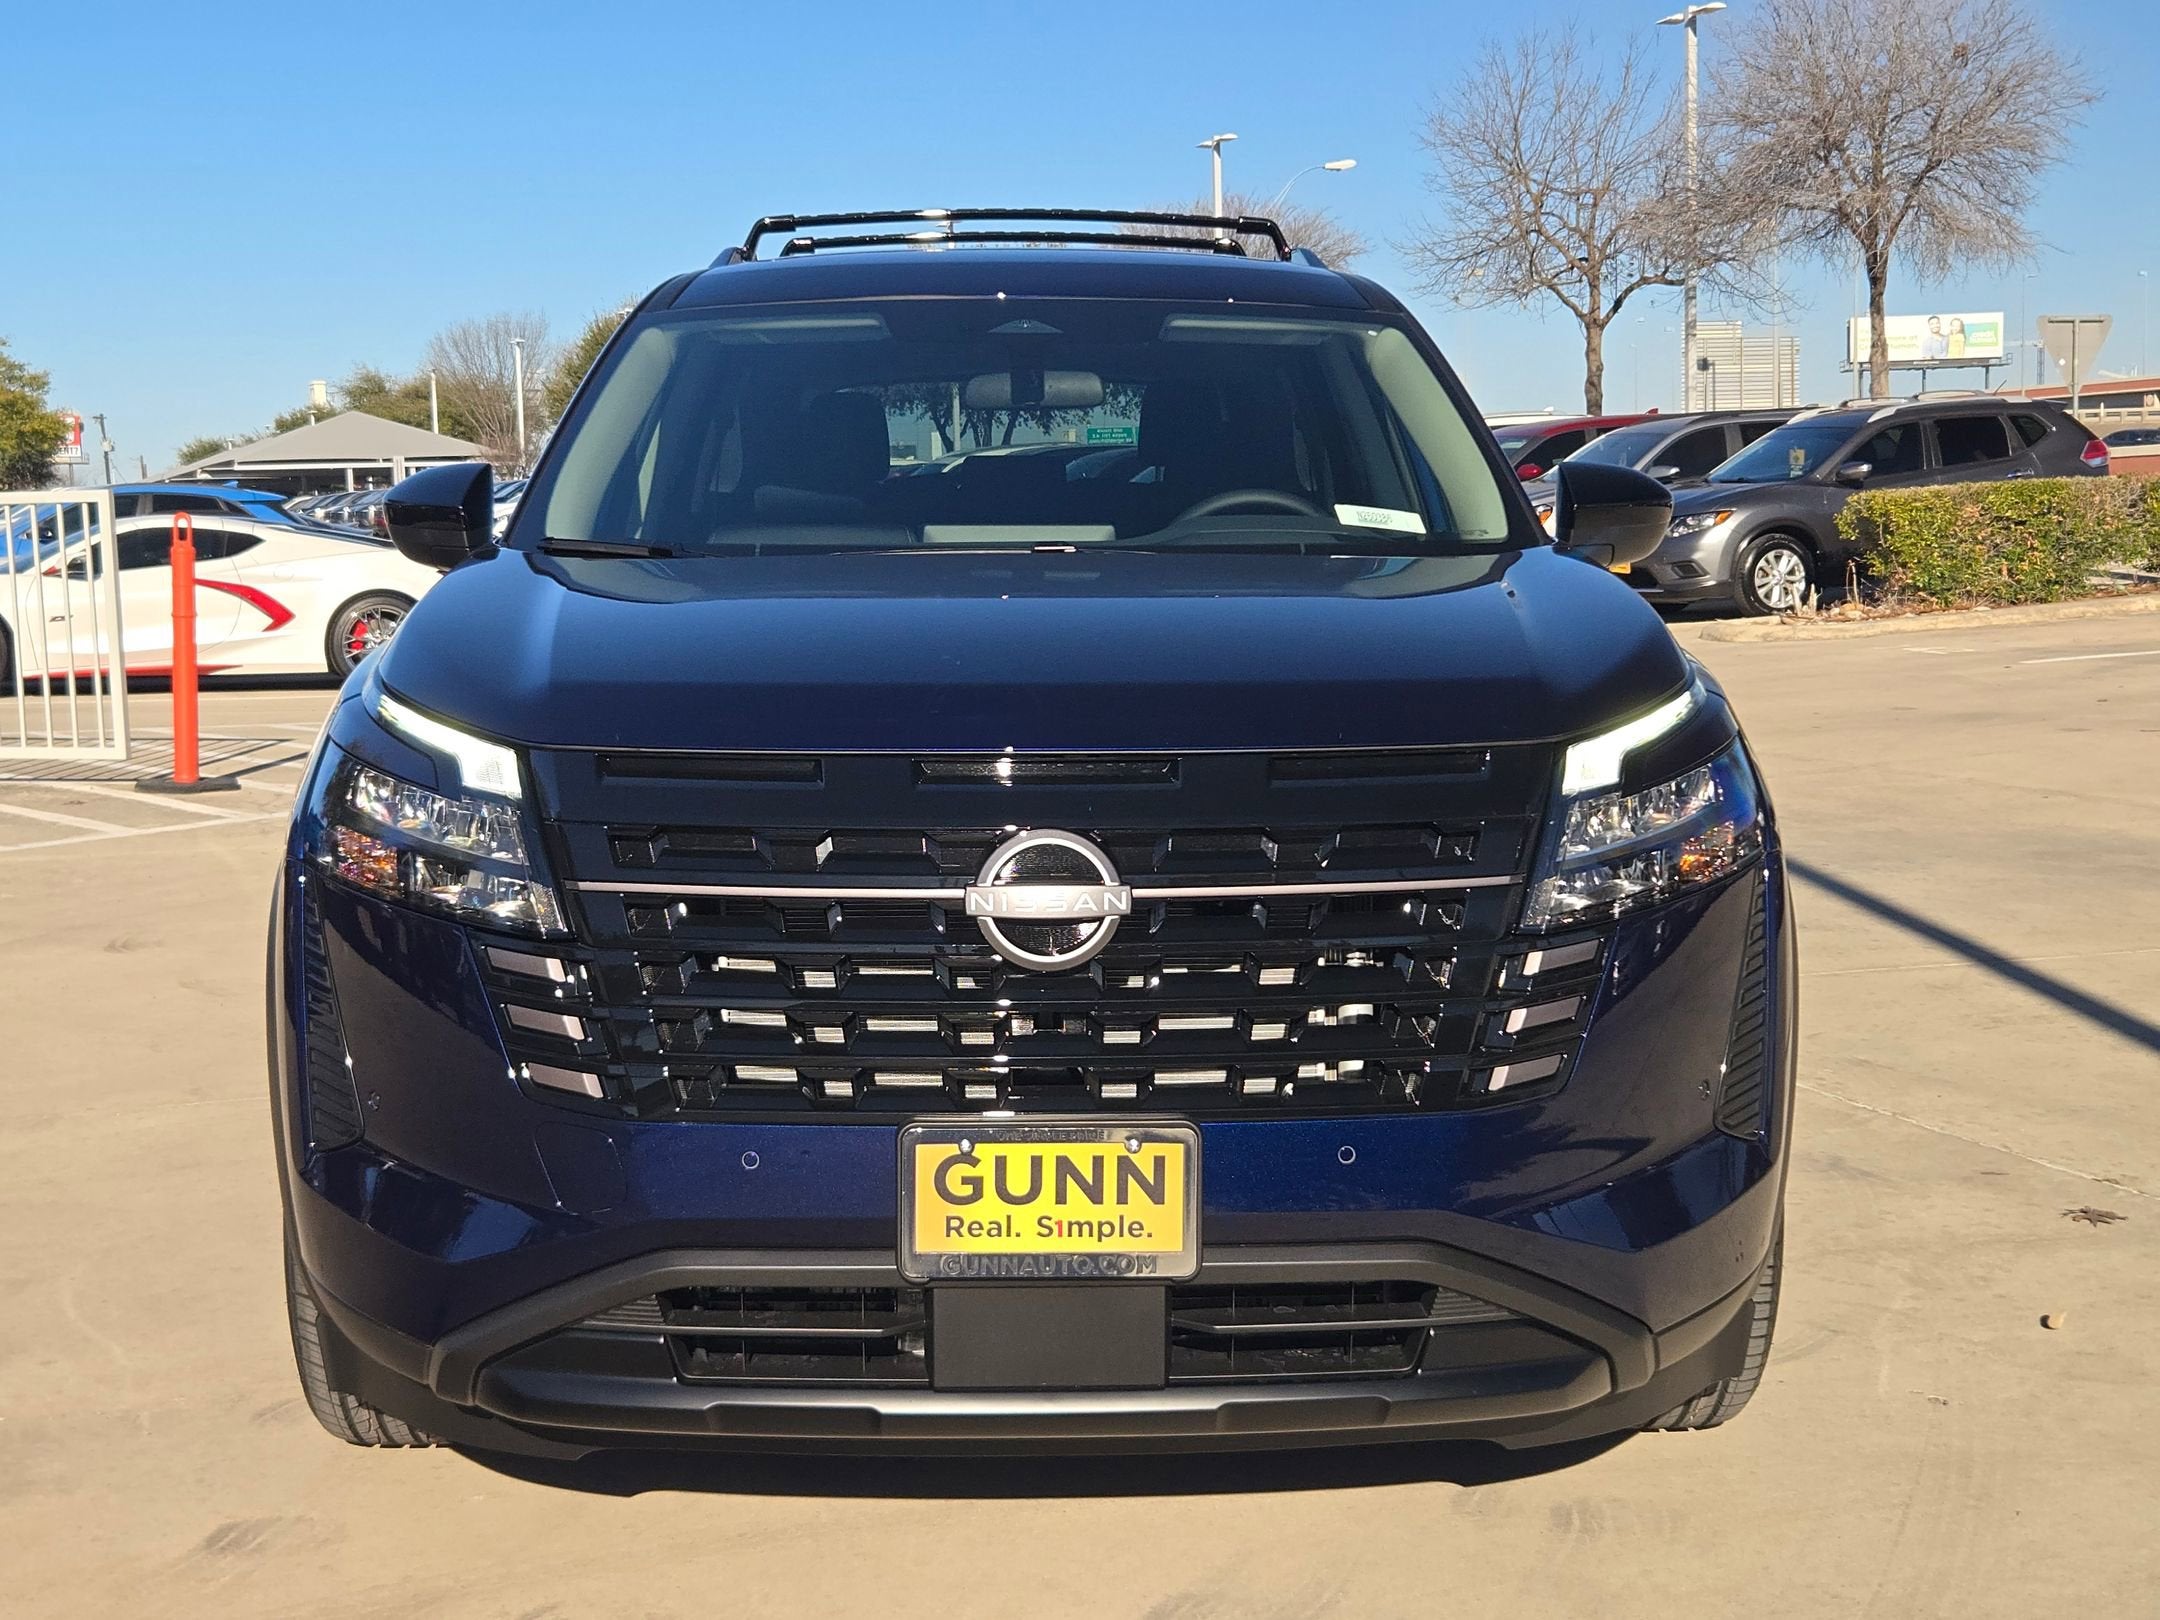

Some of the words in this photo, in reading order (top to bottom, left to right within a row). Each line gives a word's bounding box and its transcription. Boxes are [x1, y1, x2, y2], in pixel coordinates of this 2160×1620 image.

[970, 891, 1127, 912] NISSAN
[934, 1153, 1166, 1206] GUNN
[945, 1214, 1021, 1238] Real.
[940, 1254, 1158, 1275] GUNNAUTO.COM
